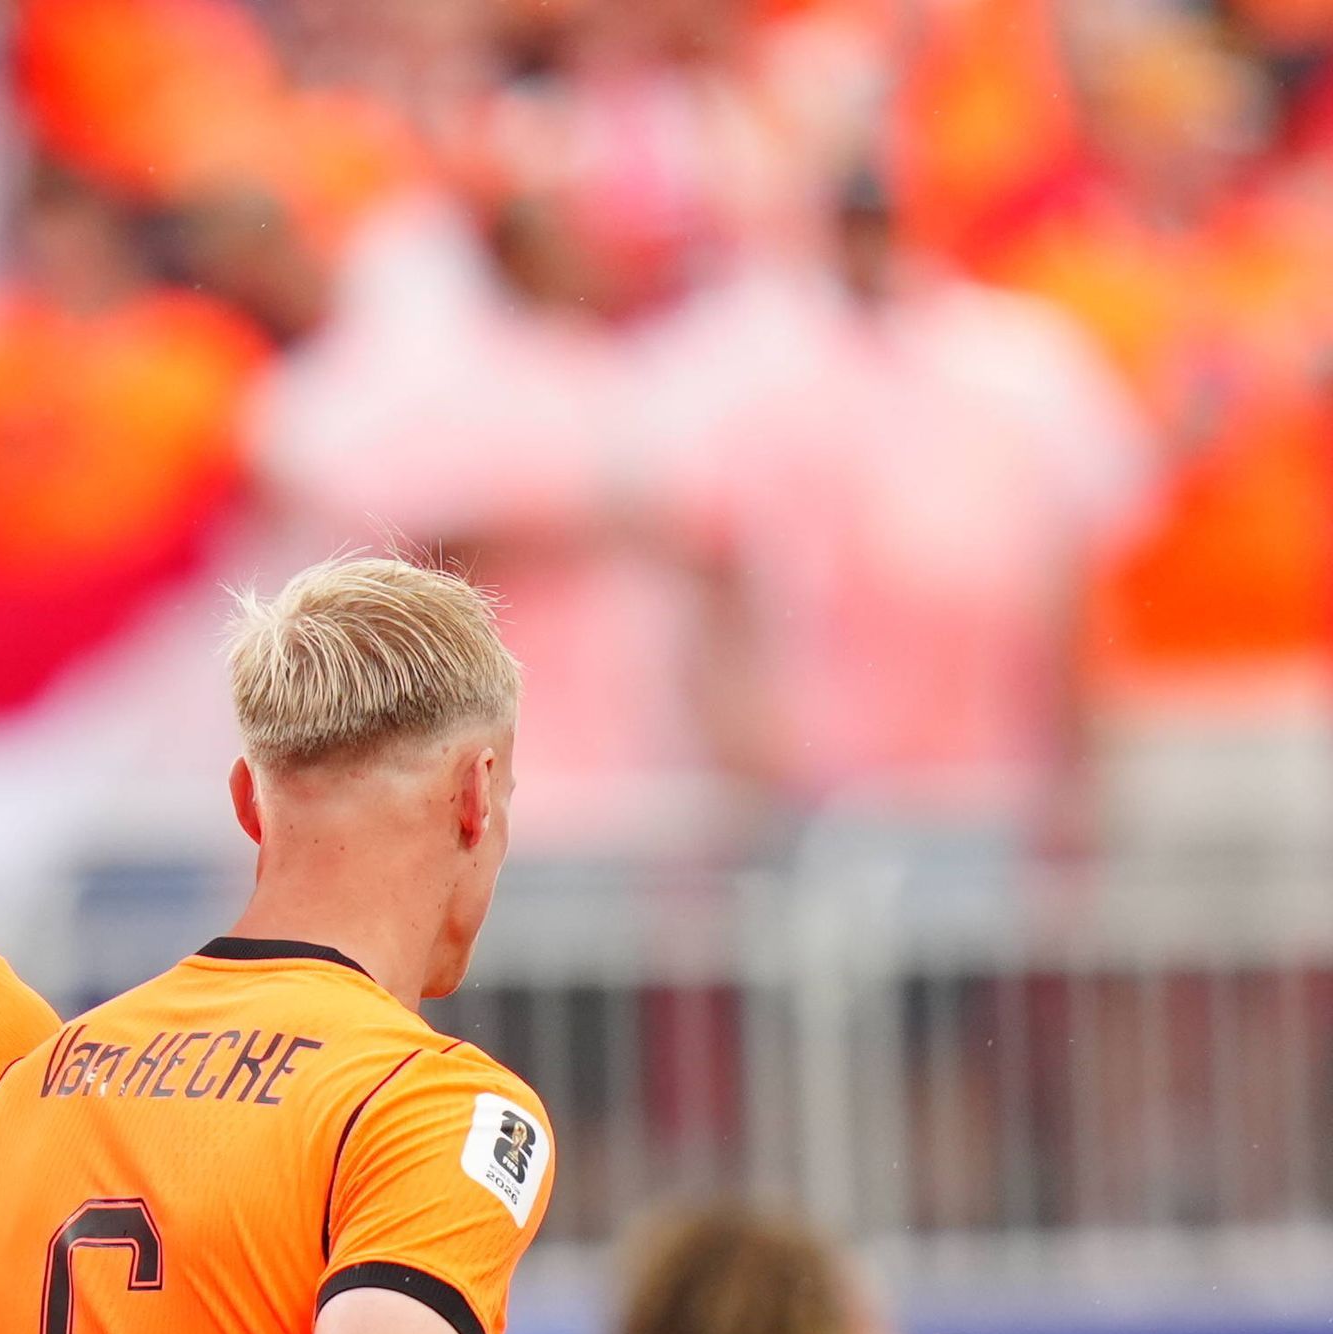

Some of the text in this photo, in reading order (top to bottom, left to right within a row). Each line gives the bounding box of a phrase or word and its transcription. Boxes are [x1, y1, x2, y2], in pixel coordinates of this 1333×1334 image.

[40, 1024, 324, 1105] Van HECKE
[486, 1170, 517, 1205] 2026
